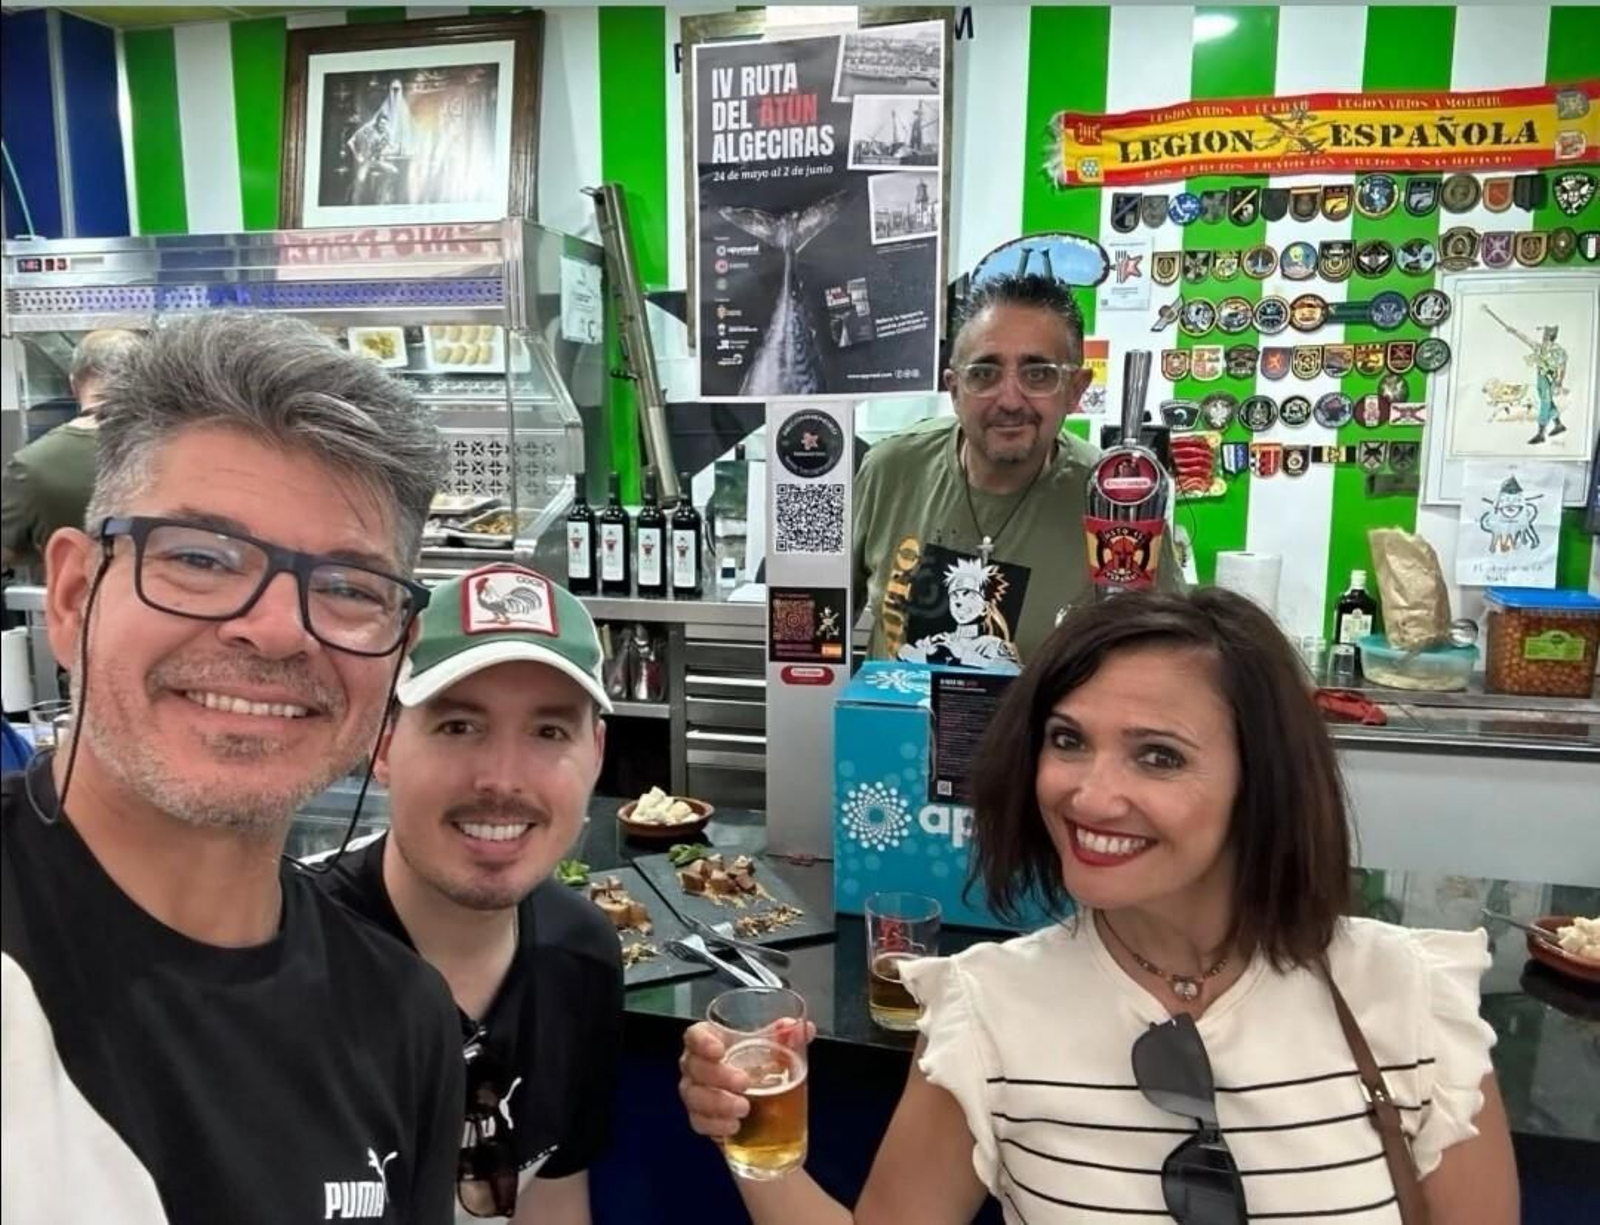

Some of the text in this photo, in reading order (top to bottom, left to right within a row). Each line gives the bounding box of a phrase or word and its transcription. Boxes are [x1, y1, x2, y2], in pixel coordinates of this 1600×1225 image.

[712, 62, 798, 99] IV RUTA
[712, 100, 753, 131] DEL
[712, 125, 835, 164] ALGECIRAS
[1118, 116, 1540, 163] LEGION ESPAÑOLA
[713, 164, 834, 182] 24 de mayo al 2 de junio
[324, 1181, 386, 1219] PUMA
